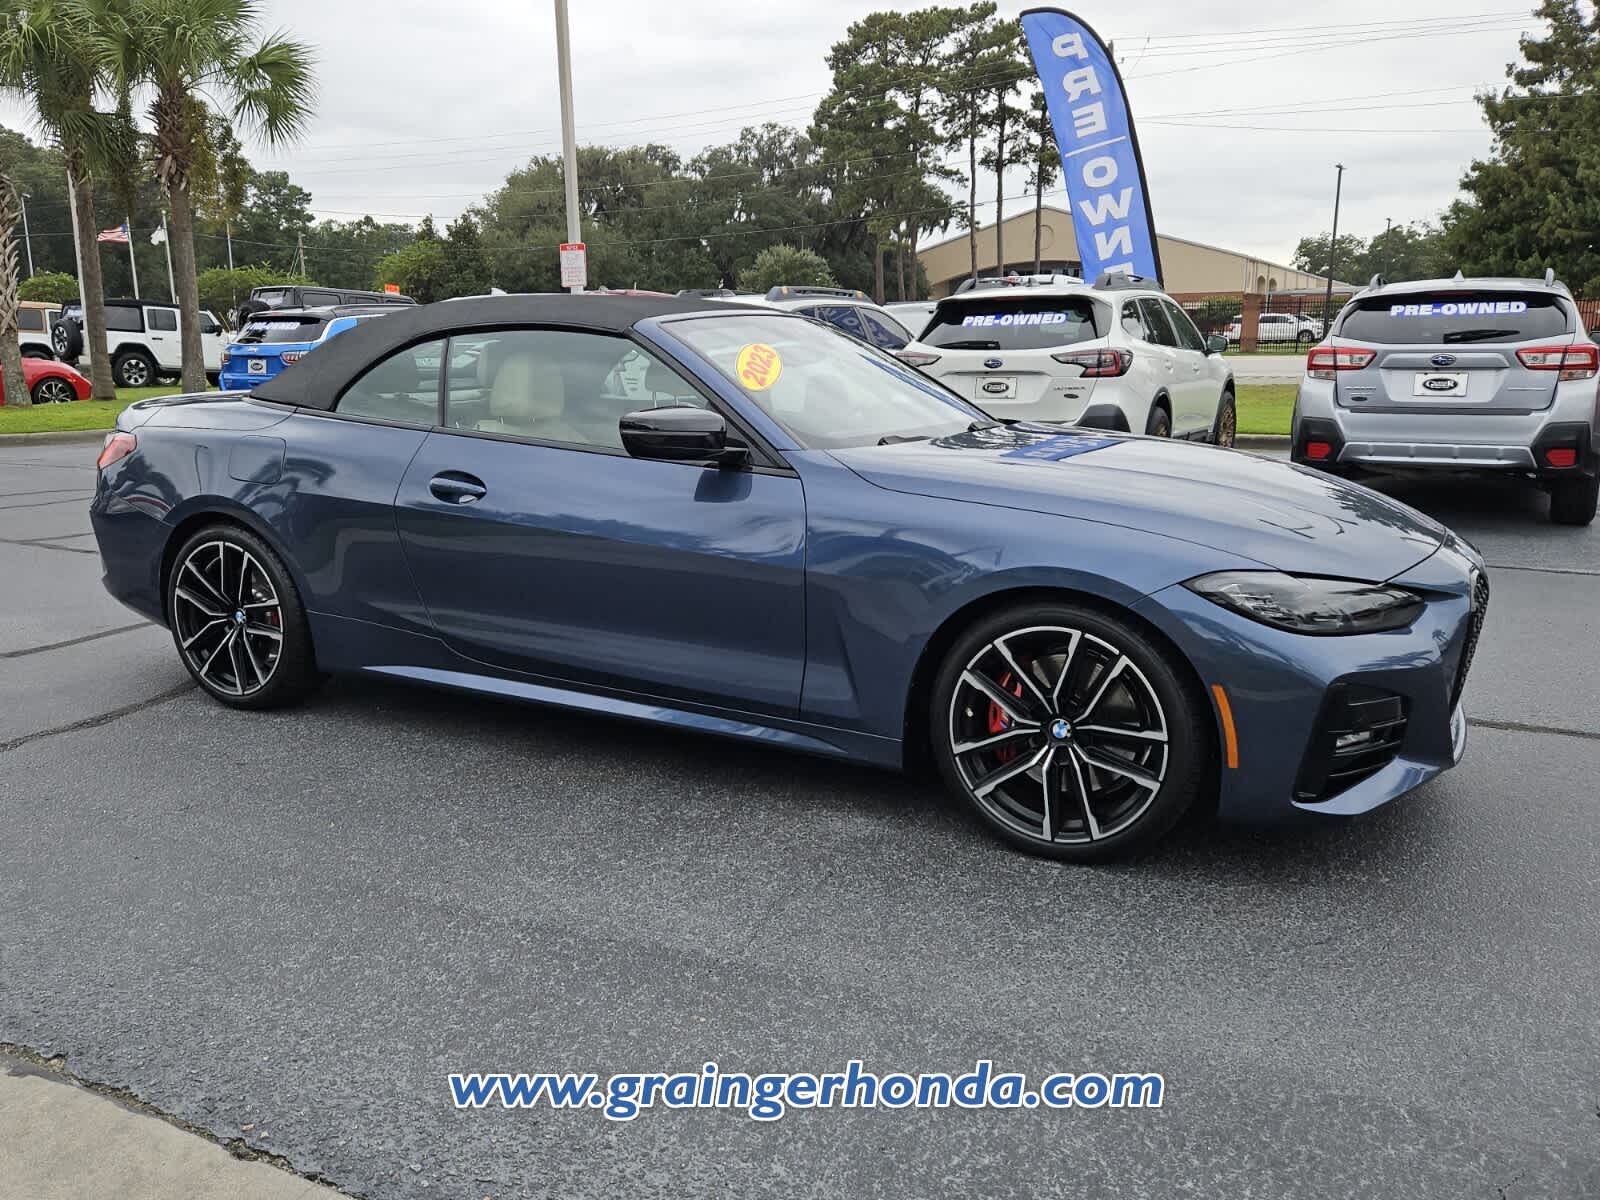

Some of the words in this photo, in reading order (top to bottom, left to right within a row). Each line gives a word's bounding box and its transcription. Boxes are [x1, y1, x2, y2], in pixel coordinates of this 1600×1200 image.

[1390, 301, 1527, 316] PRE-OWNED
[962, 313, 1067, 327] PRE-OWNED
[742, 345, 776, 386] 2023
